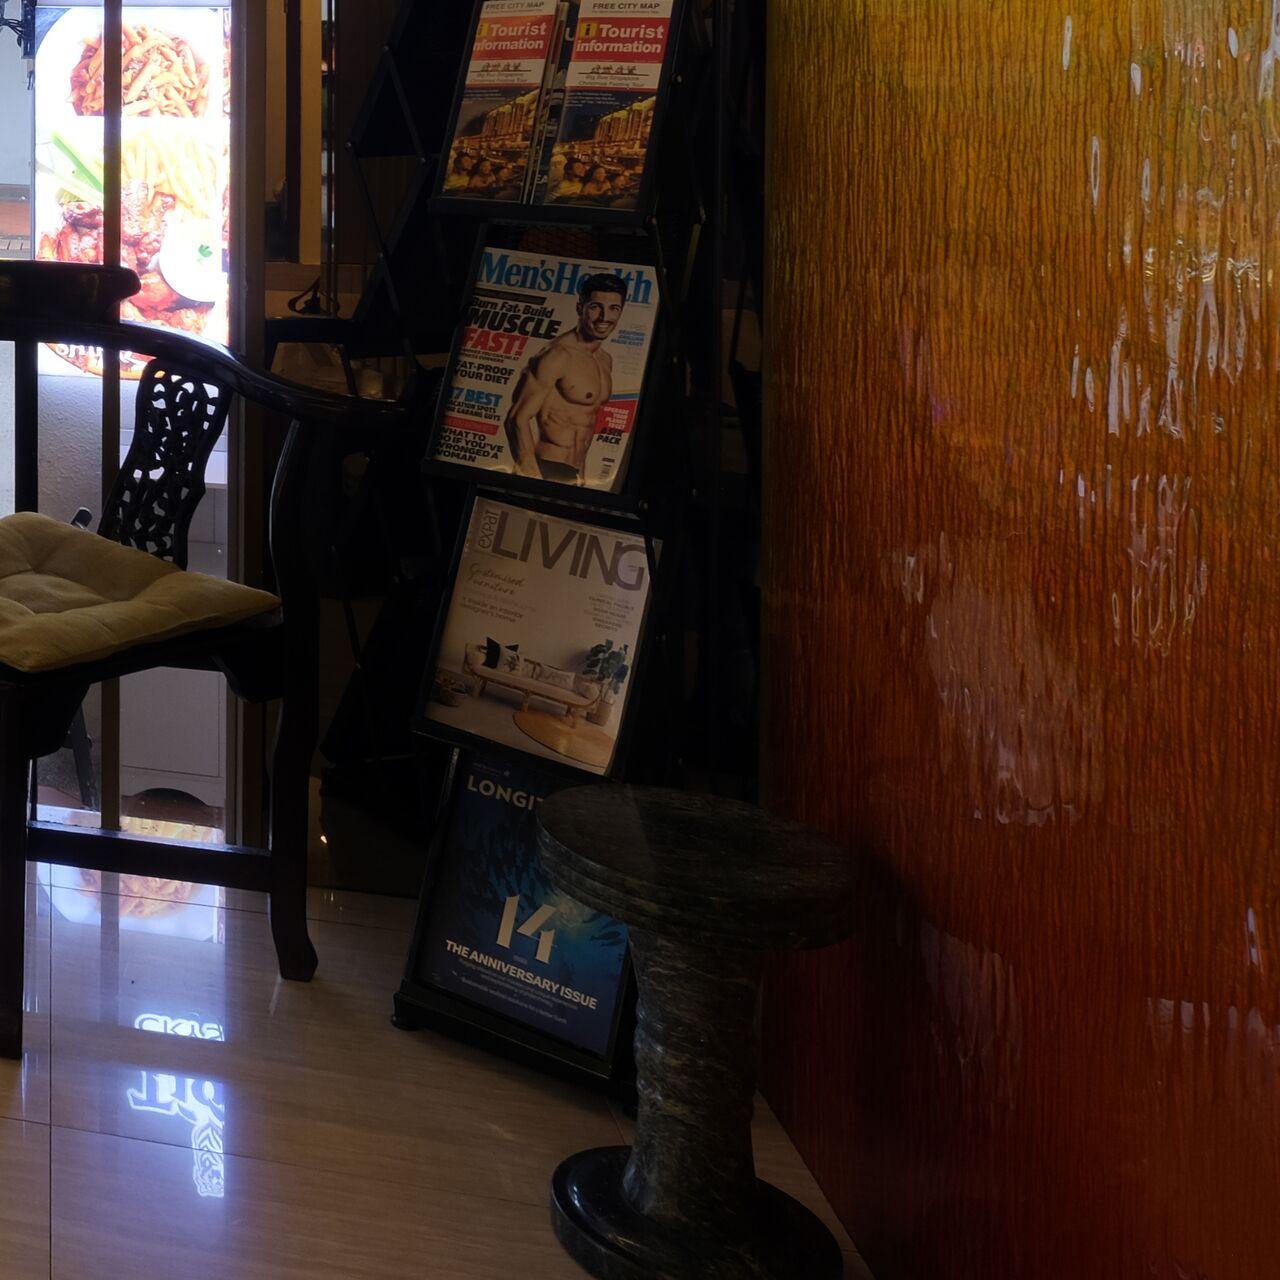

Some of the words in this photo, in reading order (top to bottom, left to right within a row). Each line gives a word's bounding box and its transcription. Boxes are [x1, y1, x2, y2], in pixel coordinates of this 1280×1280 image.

[592, 2, 617, 10] FREE
[618, 2, 638, 10] CITY
[640, 2, 660, 10] MAP
[491, 21, 548, 37] Tourist
[599, 24, 665, 39] Tourist
[473, 38, 544, 52] nformation
[576, 39, 662, 53] information
[523, 305, 555, 319] Build
[465, 306, 562, 340] MUSCLE
[464, 326, 529, 355] FAST!
[454, 368, 483, 382] YOUR
[484, 372, 510, 385] DIET
[455, 360, 515, 377] FAT-PROOF
[465, 389, 503, 407] BEST
[452, 436, 463, 445] IF
[464, 439, 504, 453] YOU'VE
[472, 432, 487, 442] TO
[478, 509, 500, 550] expat
[491, 510, 647, 592] LIVING
[496, 895, 558, 965] 14
[445, 939, 470, 960] THE
[470, 950, 560, 996] ANNIVERSARY
[560, 983, 598, 1011] ISSUE
